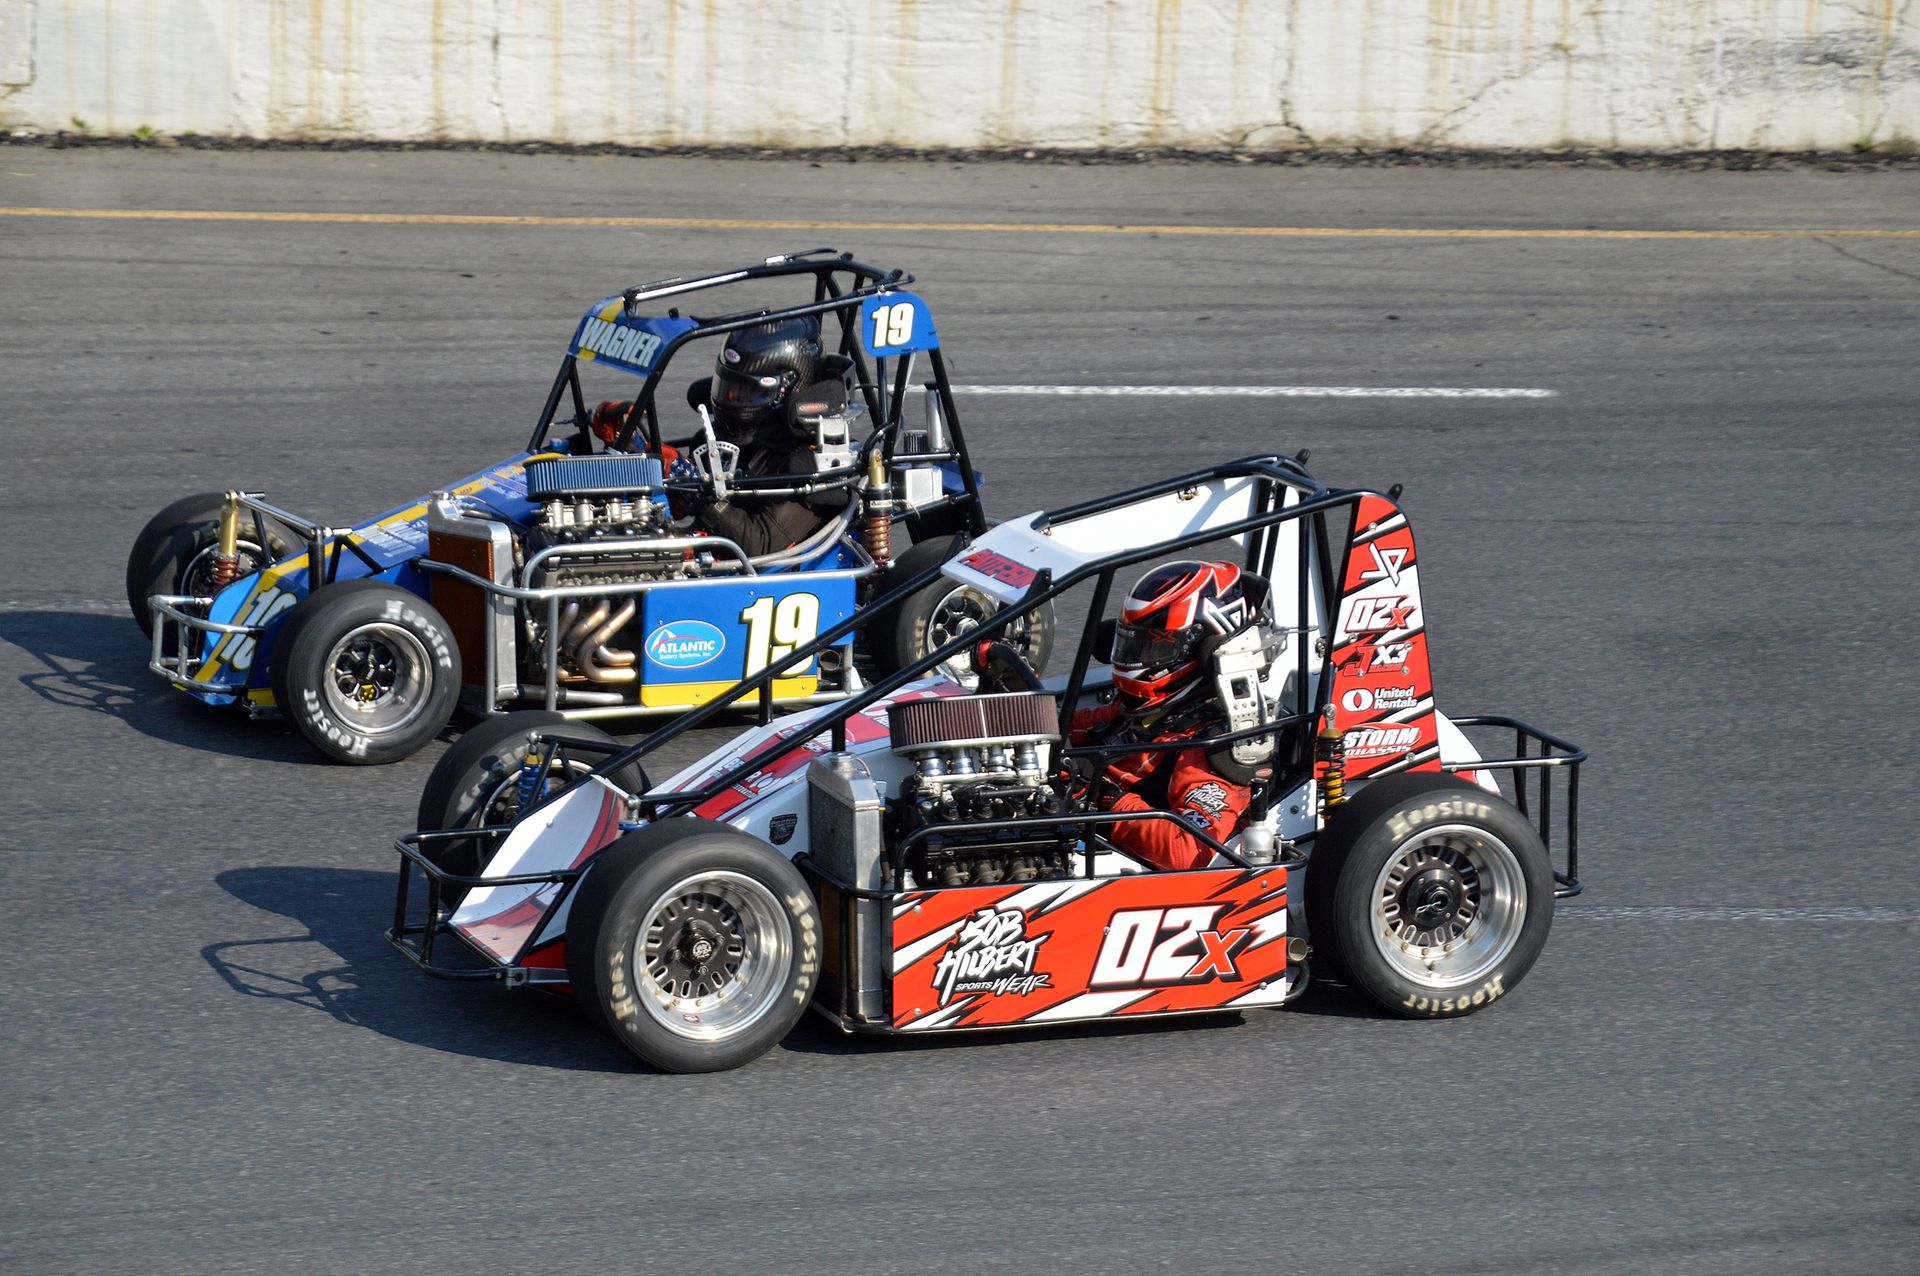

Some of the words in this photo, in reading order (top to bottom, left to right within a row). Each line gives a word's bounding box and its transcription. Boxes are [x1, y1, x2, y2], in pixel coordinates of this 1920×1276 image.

[578, 315, 661, 368] WAGNER
[870, 302, 915, 349] 19
[381, 599, 453, 669] Hoosier
[657, 640, 716, 654] ATLANTIC
[741, 591, 820, 679] 19
[1374, 686, 1414, 699] United
[1374, 697, 1418, 710] Rentals
[1343, 727, 1420, 749] STORM
[1385, 801, 1491, 843] Hoosier
[959, 908, 1023, 946] BOB
[932, 933, 1050, 1007] HILBERT
